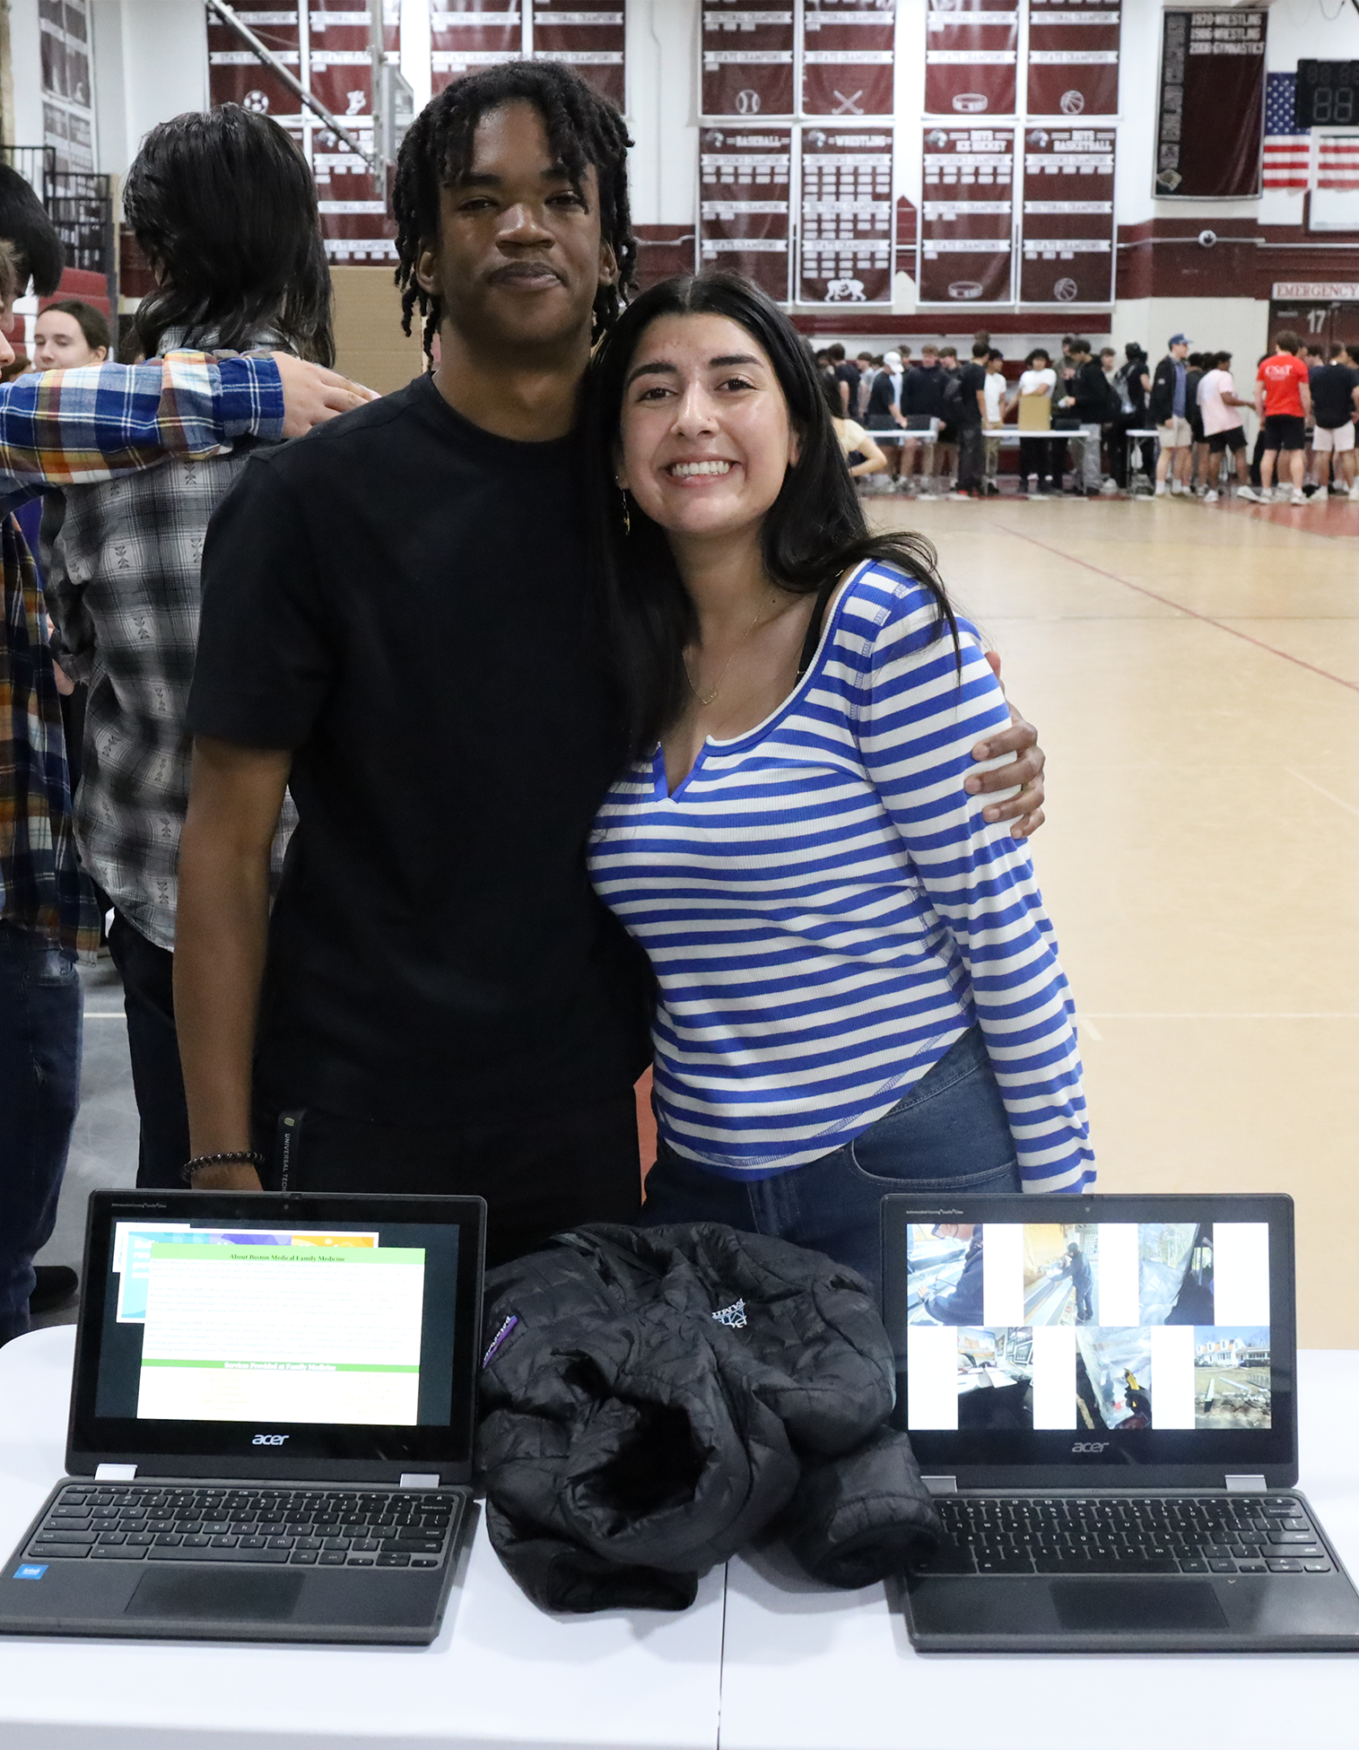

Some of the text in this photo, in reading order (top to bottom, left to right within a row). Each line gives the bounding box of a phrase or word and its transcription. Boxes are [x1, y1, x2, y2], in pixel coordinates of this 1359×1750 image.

[1053, 141, 1112, 152] BASKETBALL
[1276, 284, 1358, 297] EMERGENCY
[1307, 309, 1327, 334] 17
[282, 1133, 291, 1172] UNIVERSAL
[308, 1363, 336, 1371] Medicine
[251, 1434, 290, 1446] acer
[1071, 1442, 1110, 1453] acer
